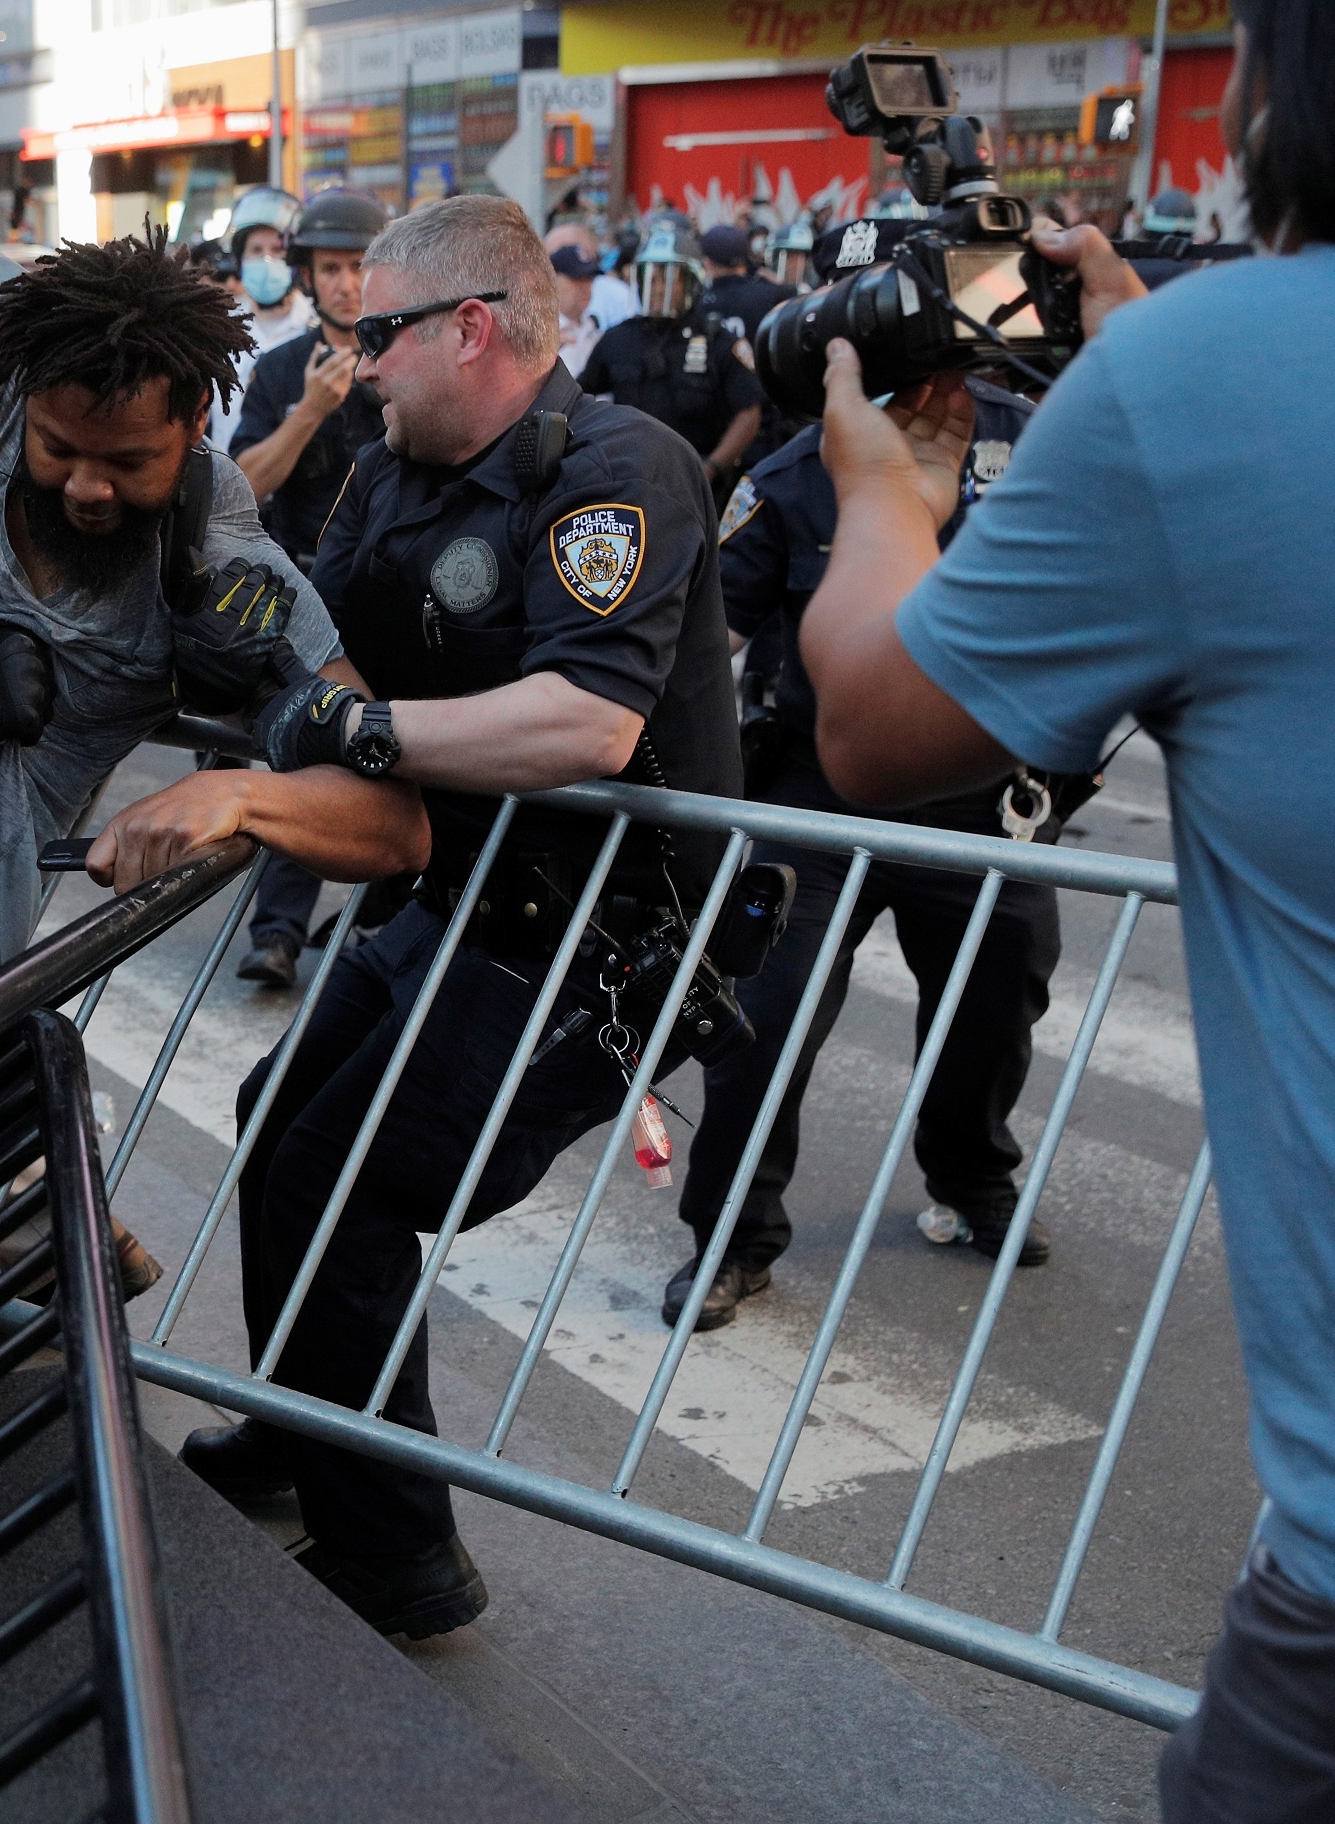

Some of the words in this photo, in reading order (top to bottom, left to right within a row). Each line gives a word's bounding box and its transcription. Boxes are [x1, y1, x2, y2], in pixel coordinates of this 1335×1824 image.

[726, 0, 822, 57] The
[826, 0, 1011, 42] Plastic
[1028, 0, 1133, 34] Bag
[572, 511, 615, 529] POLICE
[558, 522, 634, 549] DEPARTMENT
[438, 544, 463, 569] DEPUTY
[560, 560, 578, 584] CITY
[577, 584, 592, 598] OF
[607, 578, 626, 600] NEW
[622, 545, 638, 575] YORK
[450, 592, 486, 607] MATTERS
[321, 690, 337, 709] GRIP
